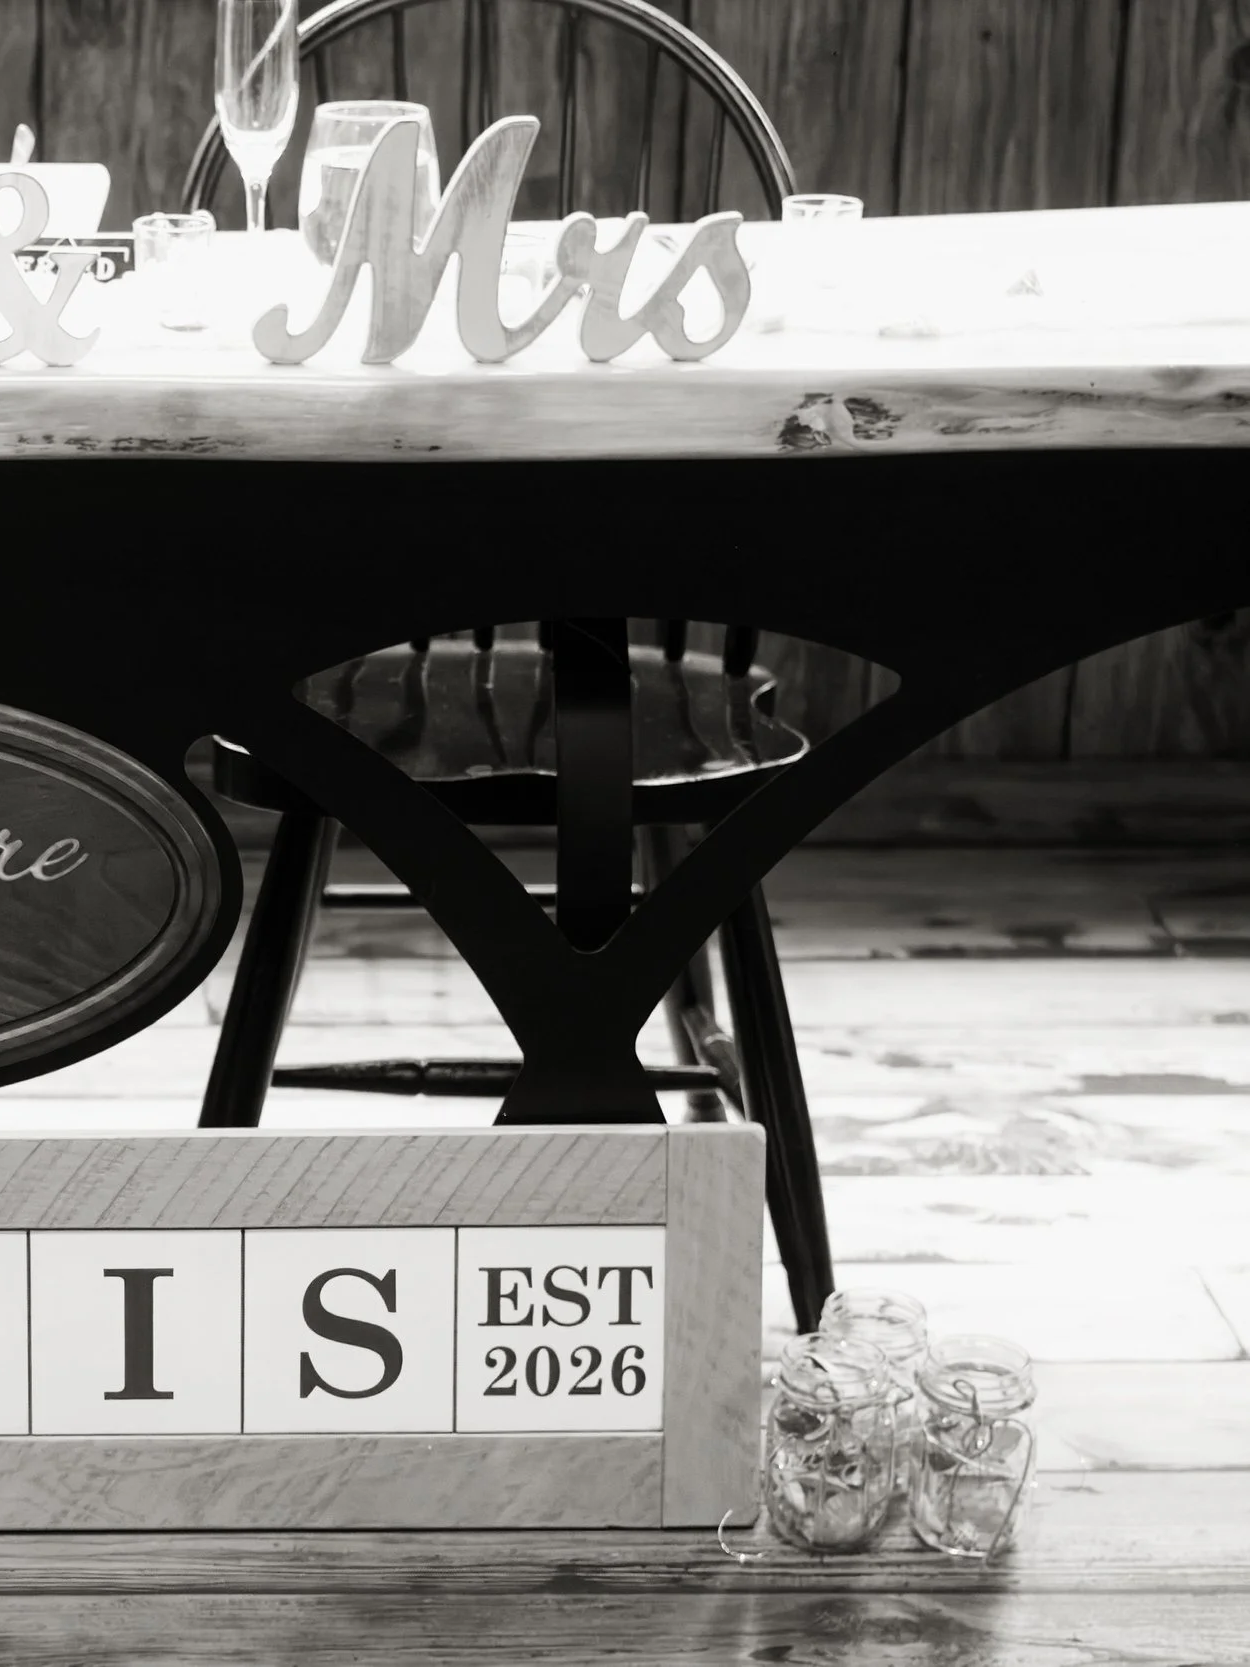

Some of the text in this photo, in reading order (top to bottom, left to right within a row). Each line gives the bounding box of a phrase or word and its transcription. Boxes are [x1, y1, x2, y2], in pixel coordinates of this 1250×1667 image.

[252, 115, 752, 364] Mrs
[477, 1265, 654, 1328] EST
[482, 1344, 648, 1397] 2026
